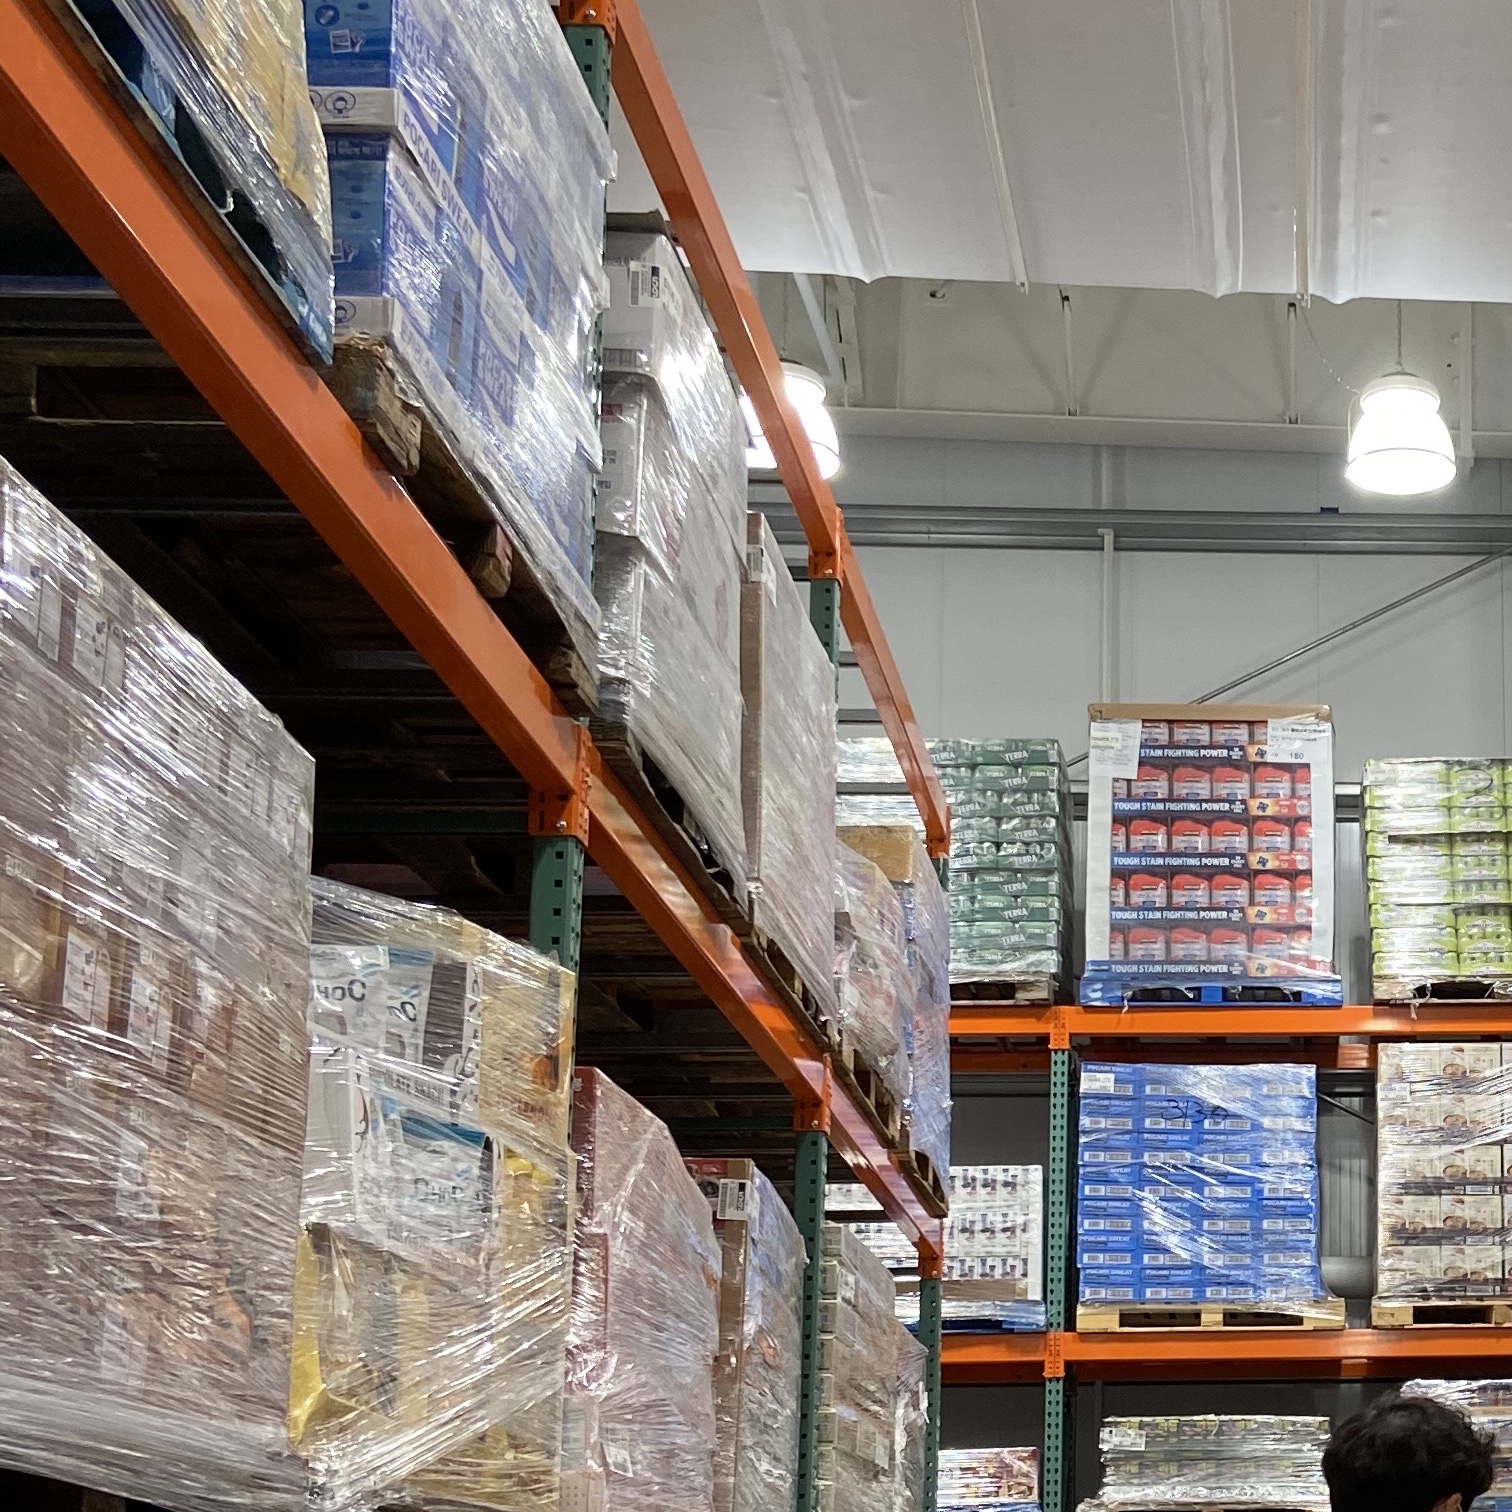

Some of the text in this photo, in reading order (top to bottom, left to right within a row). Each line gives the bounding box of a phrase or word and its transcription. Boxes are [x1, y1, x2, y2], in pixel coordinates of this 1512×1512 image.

[403, 113, 475, 243] POCARI SWEAT
[1004, 750, 1028, 762] TERRA
[1141, 749, 1163, 757] STAIN
[1164, 749, 1200, 757] FIGHTING
[1200, 749, 1228, 758] POWER
[1002, 776, 1028, 788] TERRA
[1016, 803, 1040, 815] TERRA
[1114, 801, 1140, 811] TOUGH
[1142, 802, 1164, 811] STAIN
[1166, 802, 1201, 811] FIGHTING
[1202, 802, 1229, 811] POWER
[1014, 829, 1038, 840] TERRA
[1013, 854, 1037, 866] TERRA
[1113, 857, 1229, 866] TOUGH STAIN FIGHTING POWER
[1003, 881, 1028, 893] TERRA
[1003, 907, 1028, 920] TERRA
[1111, 910, 1228, 920] TOUGH STAIN FIGHTING POWER
[1001, 933, 1025, 948] TERRA
[1111, 964, 1228, 973] TOUGH STAIN FIGHTING POWER
